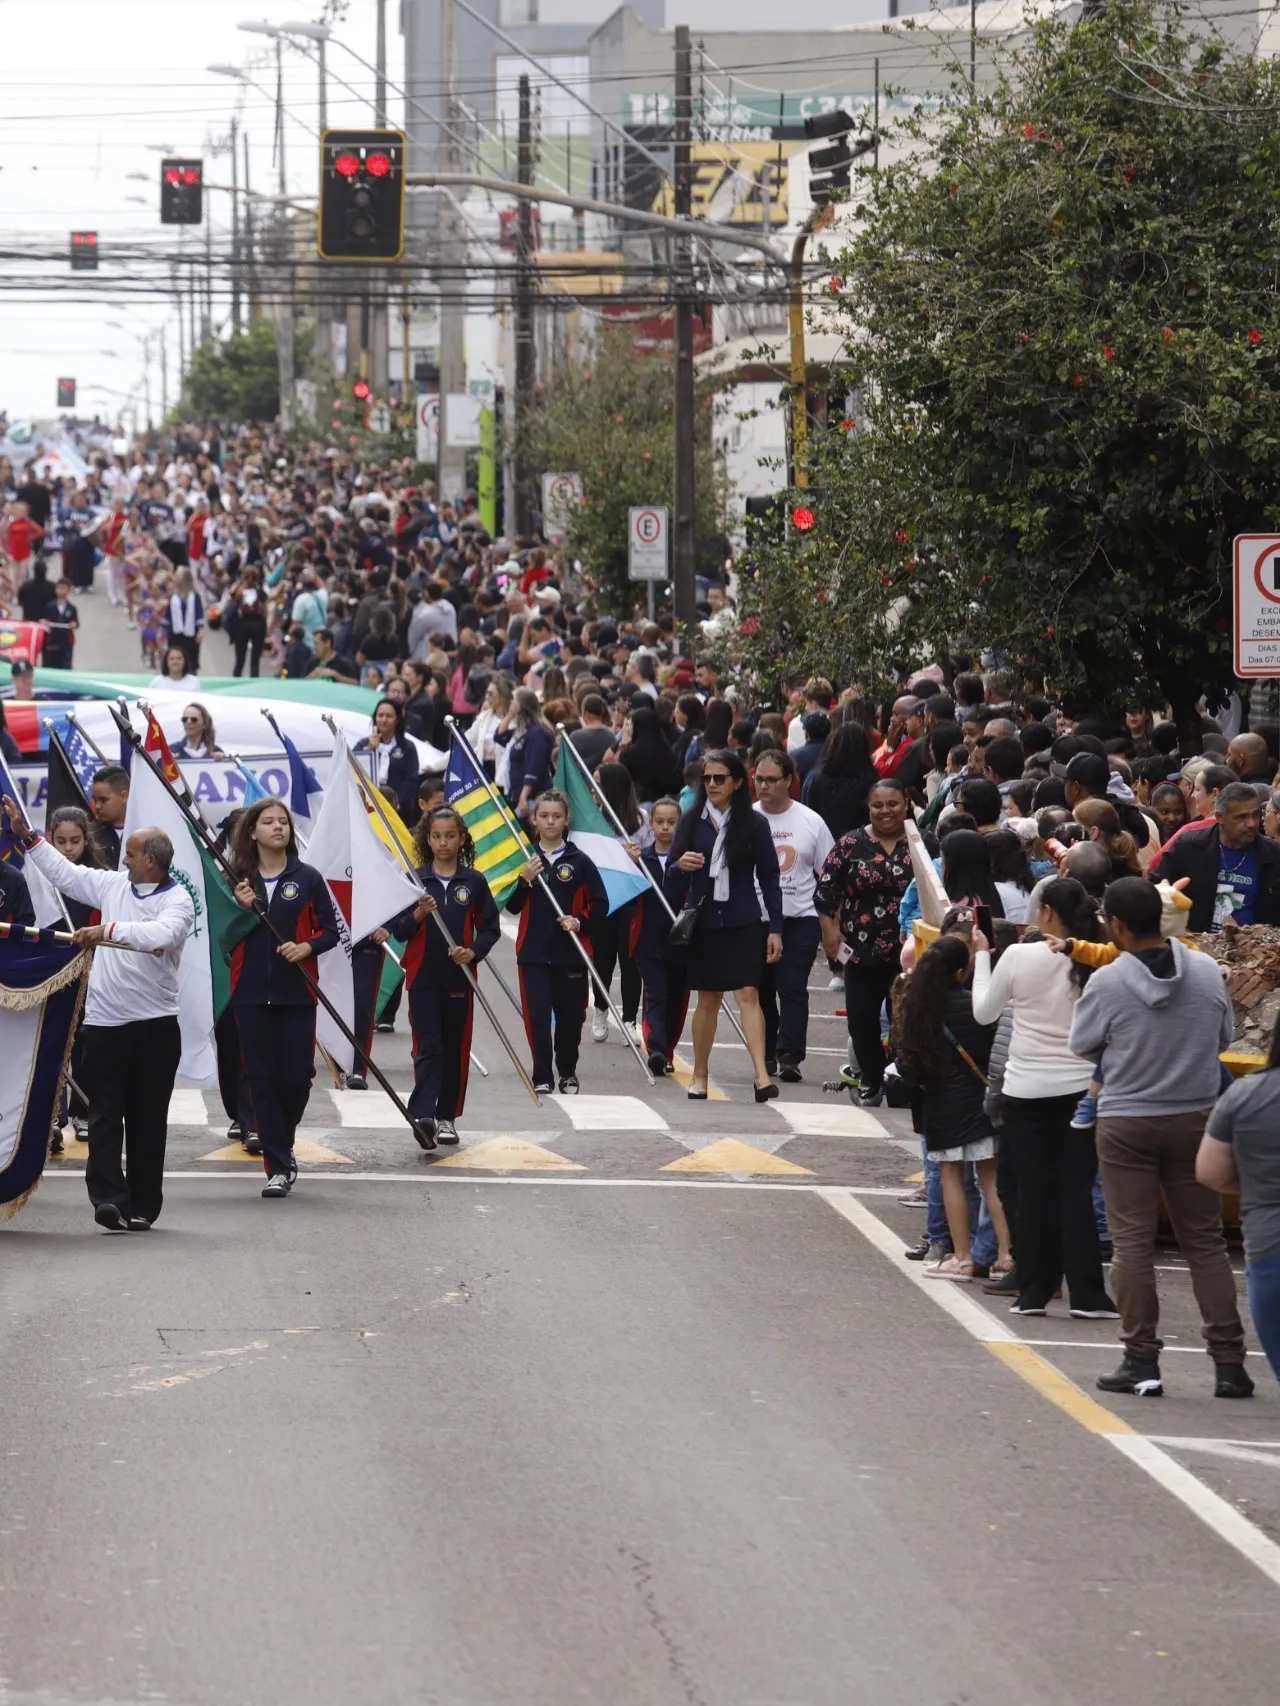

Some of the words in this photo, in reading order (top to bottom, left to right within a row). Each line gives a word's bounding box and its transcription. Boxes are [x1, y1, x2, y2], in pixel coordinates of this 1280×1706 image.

[644, 519, 653, 536] E
[1261, 607, 1280, 615] EXC
[1258, 644, 1277, 652] DIAS
[1248, 656, 1263, 664] Das
